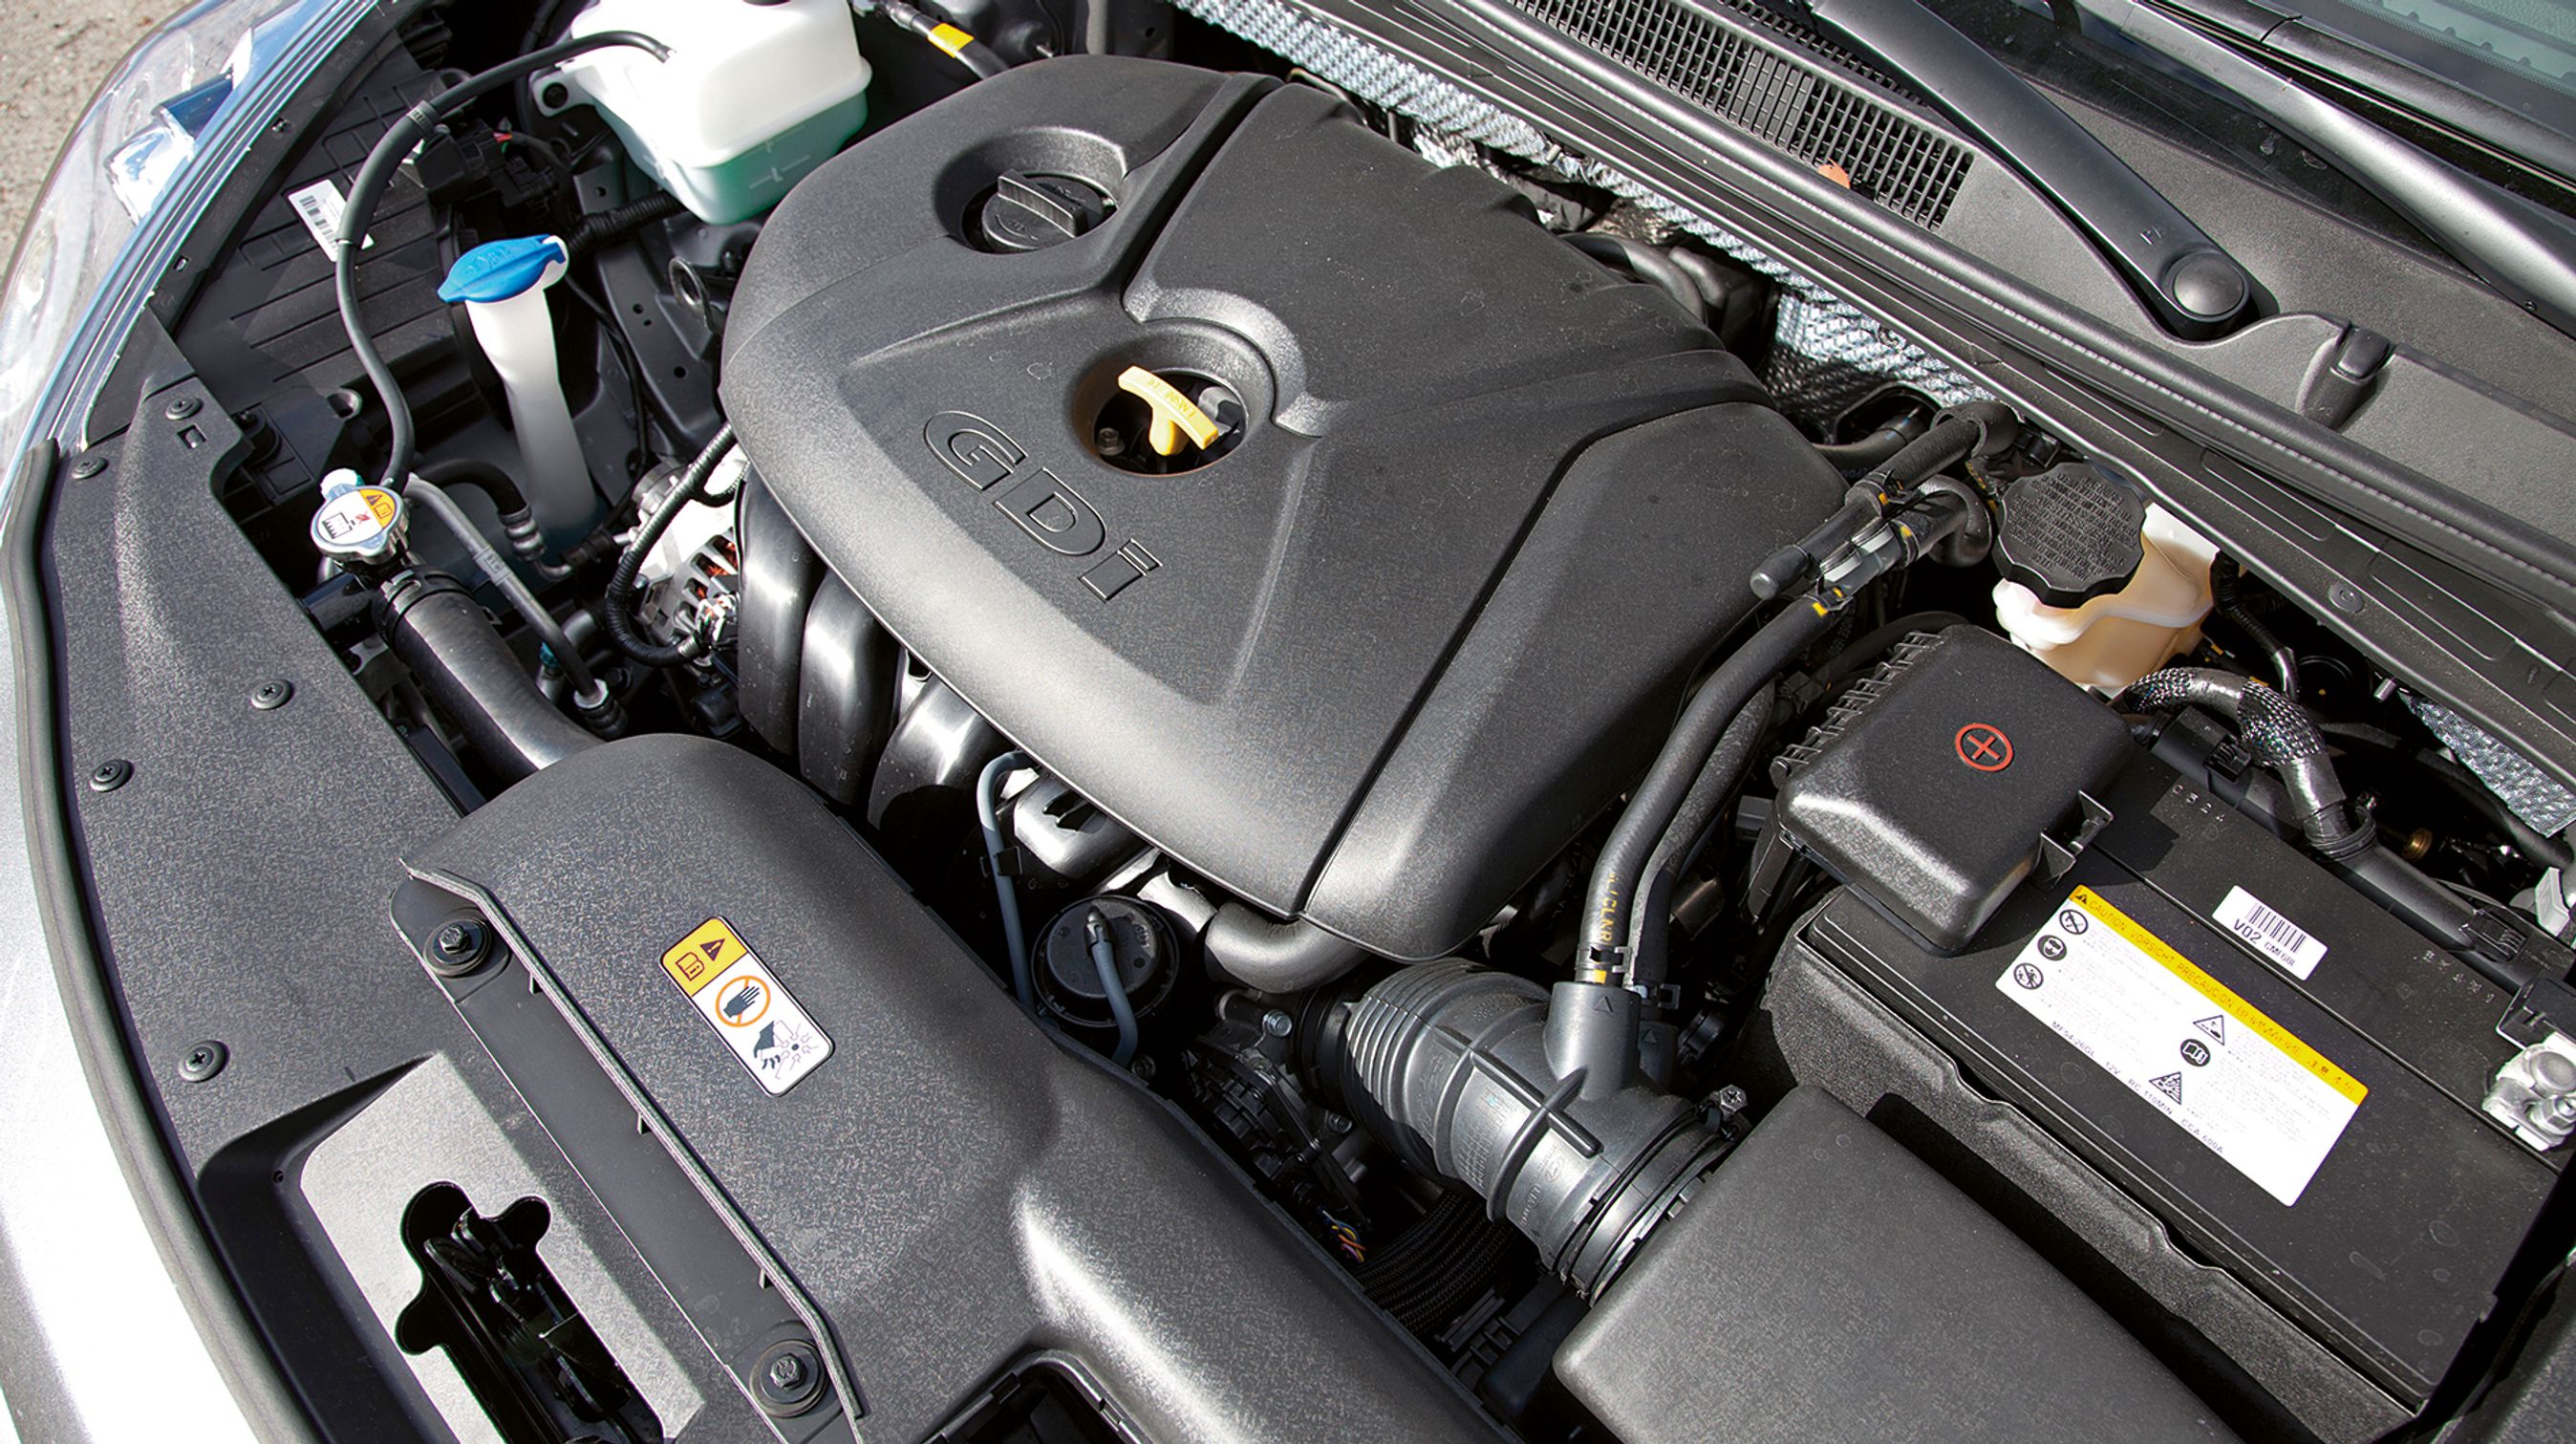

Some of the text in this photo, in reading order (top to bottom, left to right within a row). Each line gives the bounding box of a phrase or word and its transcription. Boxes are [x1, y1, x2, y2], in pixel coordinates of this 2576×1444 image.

[922, 409, 1164, 604] GDi
[2089, 899, 2126, 932] CAUTION
[2131, 929, 2176, 963] VORSICHT
[2233, 917, 2262, 944] V02
[2104, 1061, 2121, 1076] 12V
[2128, 1078, 2141, 1092] RC
[2180, 1118, 2200, 1136] CCA
